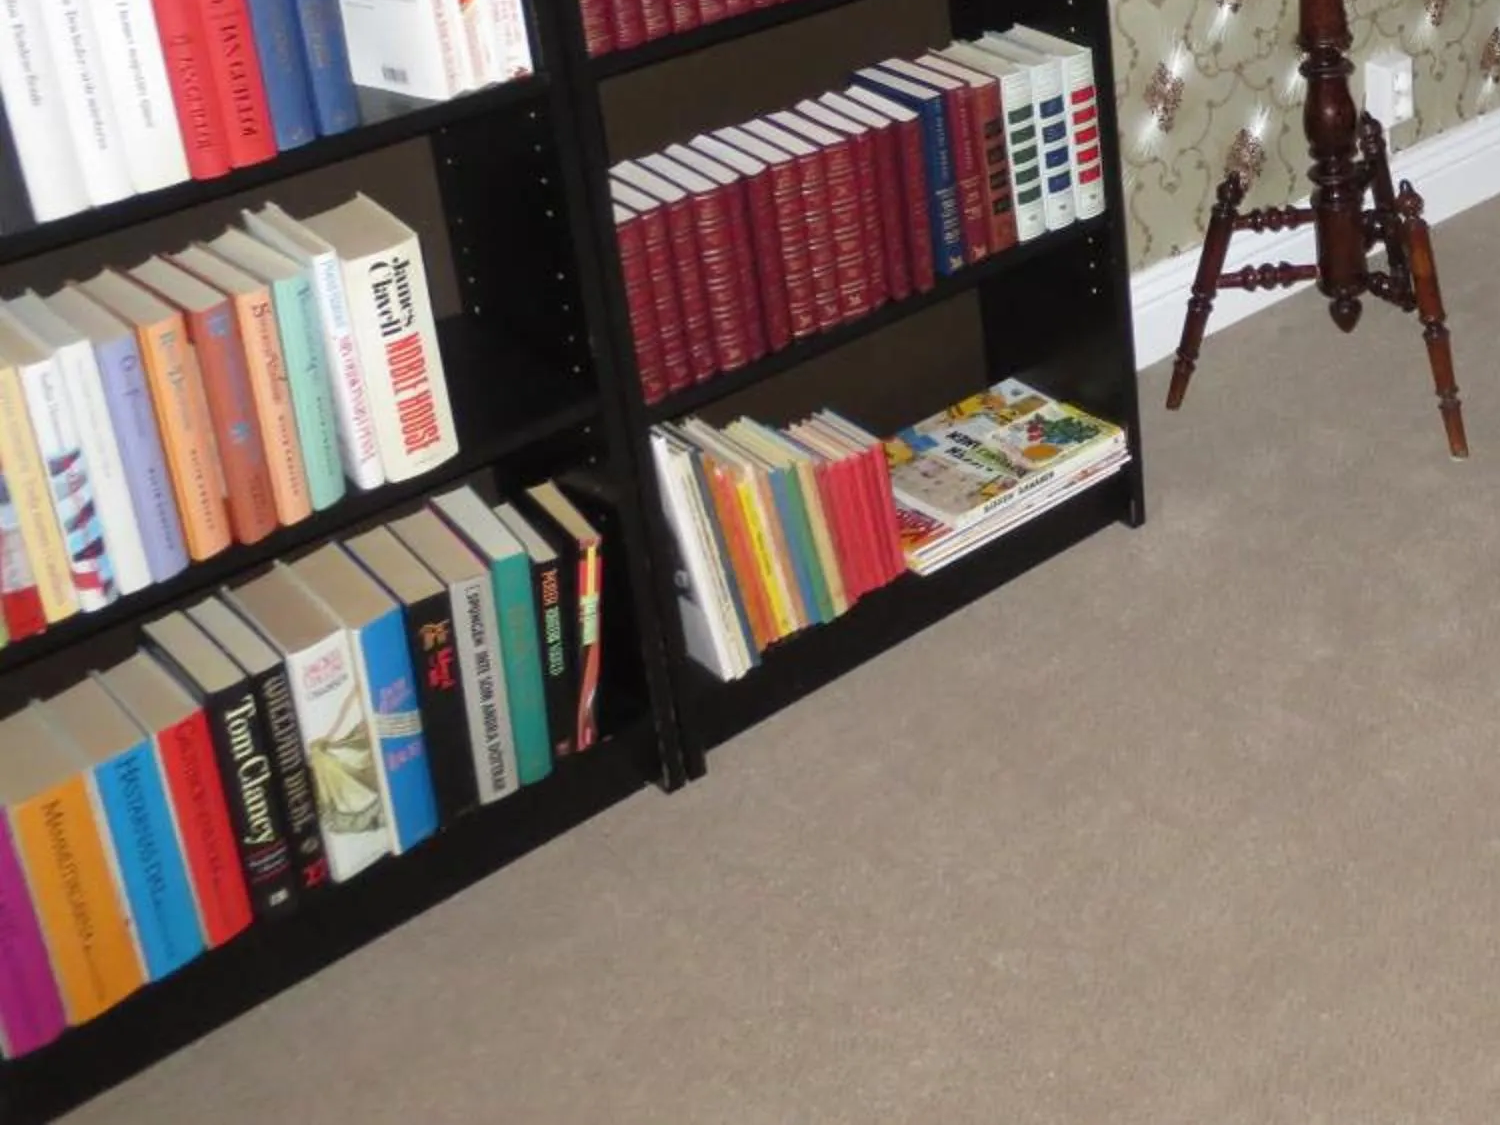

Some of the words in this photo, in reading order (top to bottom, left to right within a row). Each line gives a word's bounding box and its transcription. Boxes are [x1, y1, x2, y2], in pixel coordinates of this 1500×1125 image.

[369, 261, 402, 337] Clavell
[392, 257, 416, 328] James
[397, 389, 441, 455] HOUSE
[223, 691, 255, 761] Tom
[238, 755, 275, 845] Clancy
